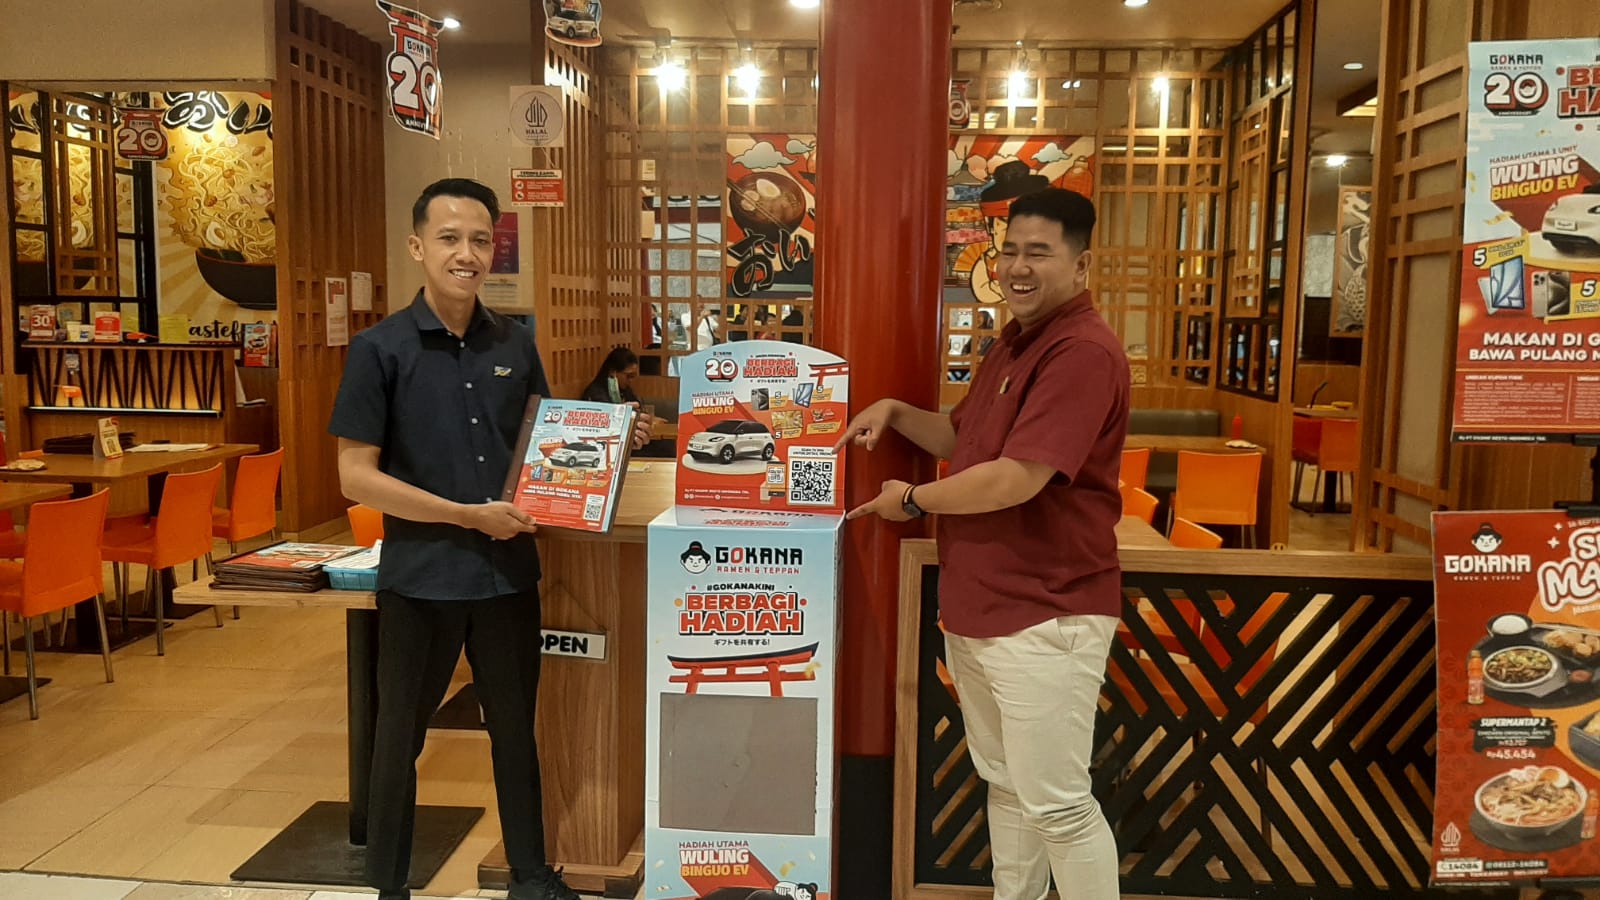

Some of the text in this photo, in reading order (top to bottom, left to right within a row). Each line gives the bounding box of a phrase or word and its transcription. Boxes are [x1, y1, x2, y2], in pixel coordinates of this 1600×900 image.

[1490, 55, 1543, 65] GOKANA
[391, 55, 438, 115] 20
[1485, 72, 1546, 106] 20
[119, 128, 163, 152] 20
[1490, 155, 1521, 164] HADIAH
[1522, 151, 1550, 160] UTAMA
[1558, 145, 1578, 154] UNIT
[1491, 156, 1580, 186] WULING
[1491, 174, 1580, 201] BINGUO EV
[1473, 248, 1487, 267] 5
[1581, 280, 1598, 297] 5
[32, 315, 50, 328] 30
[1484, 332, 1600, 347] MAKAN DI G
[1469, 348, 1515, 362] BAWA
[1520, 349, 1588, 362] PULANG
[705, 358, 738, 378] 20
[746, 358, 796, 368] BERBAGI
[743, 367, 798, 378] HADIAH
[692, 396, 735, 407] WULING
[544, 411, 562, 423] 20
[692, 406, 735, 416] BINGUO EV
[775, 431, 782, 439] 5
[1574, 533, 1600, 561] S
[715, 547, 803, 566] GOKANA
[764, 567, 800, 575] TEPPAN
[1444, 555, 1531, 574] GOKANA
[707, 583, 775, 592] #GOKANAKINI
[686, 593, 796, 611] BERBAGI
[680, 611, 804, 635] HADIAH
[1480, 718, 1540, 727] SUPERMANTAP
[679, 840, 749, 849] HADIAH UTAMA
[680, 849, 750, 865] WULING
[681, 864, 749, 878] BINGUO EV
